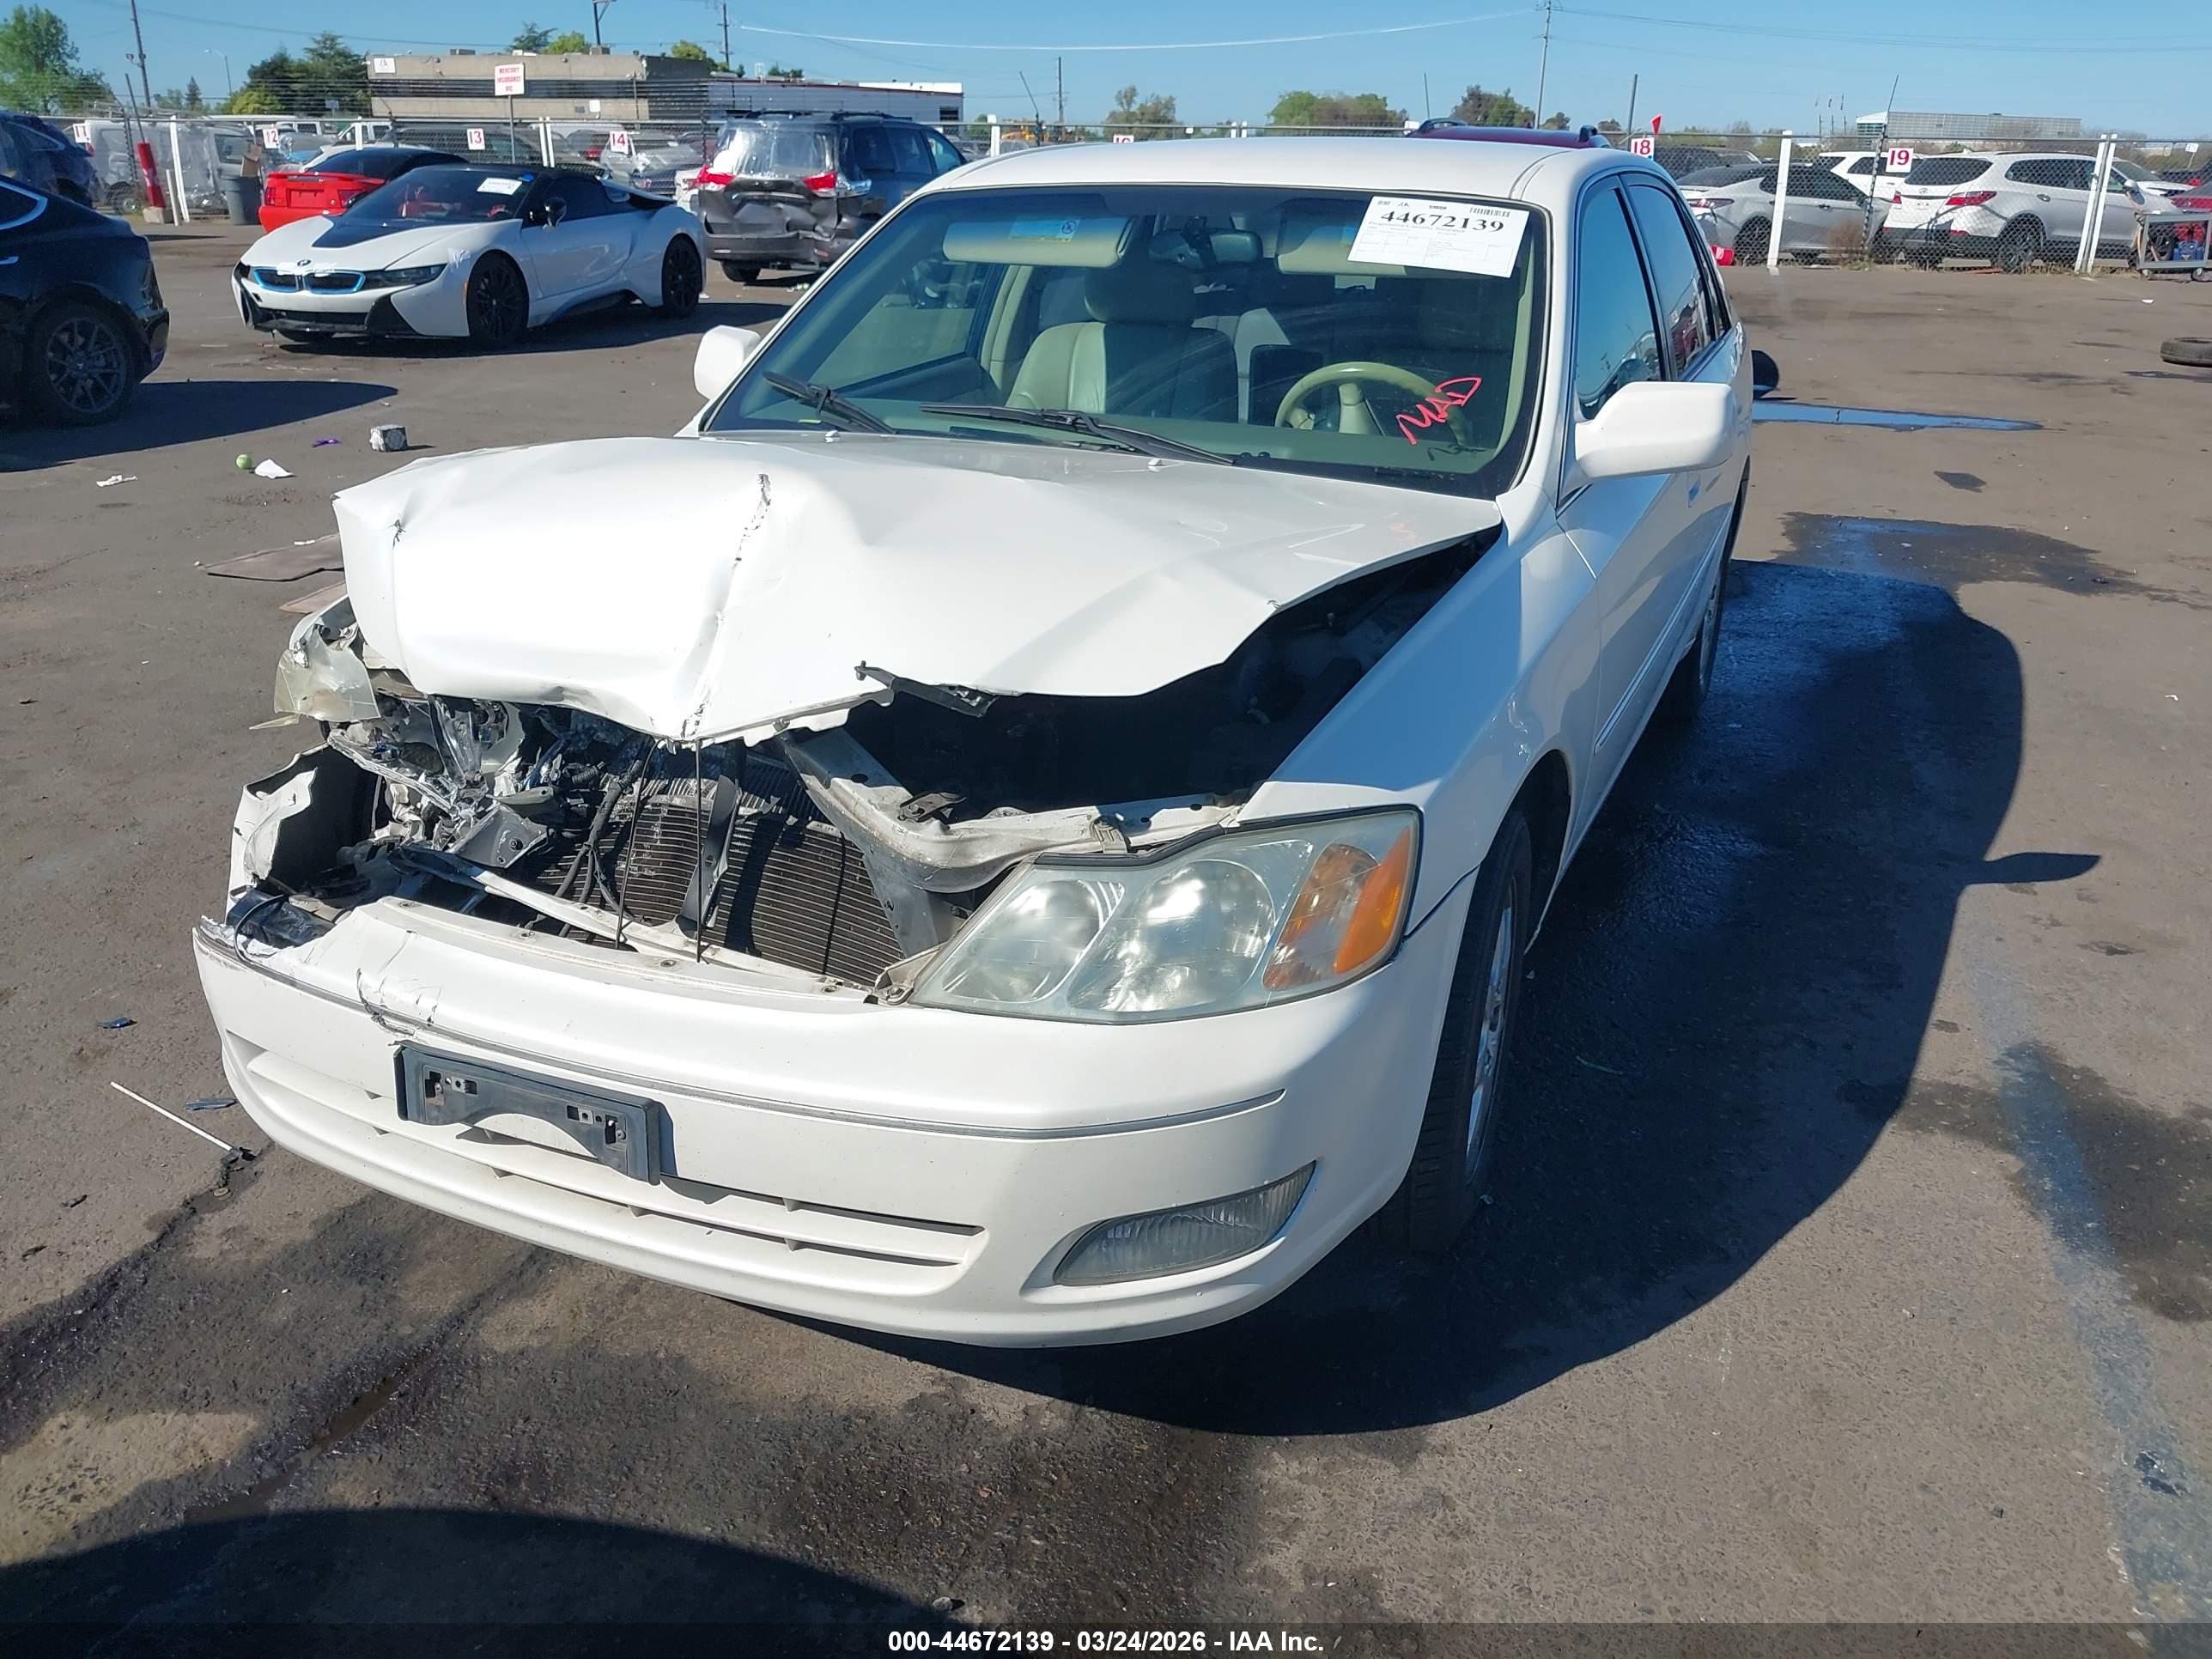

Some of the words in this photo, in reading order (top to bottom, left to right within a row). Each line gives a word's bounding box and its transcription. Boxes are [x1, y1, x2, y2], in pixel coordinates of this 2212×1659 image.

[75, 125, 87, 137] 11
[266, 130, 277, 143] 12
[469, 131, 482, 144] 13
[612, 133, 625, 146] 14
[1634, 140, 1650, 155] 18
[1890, 150, 1909, 165] 19
[1381, 210, 1504, 232] 44672139
